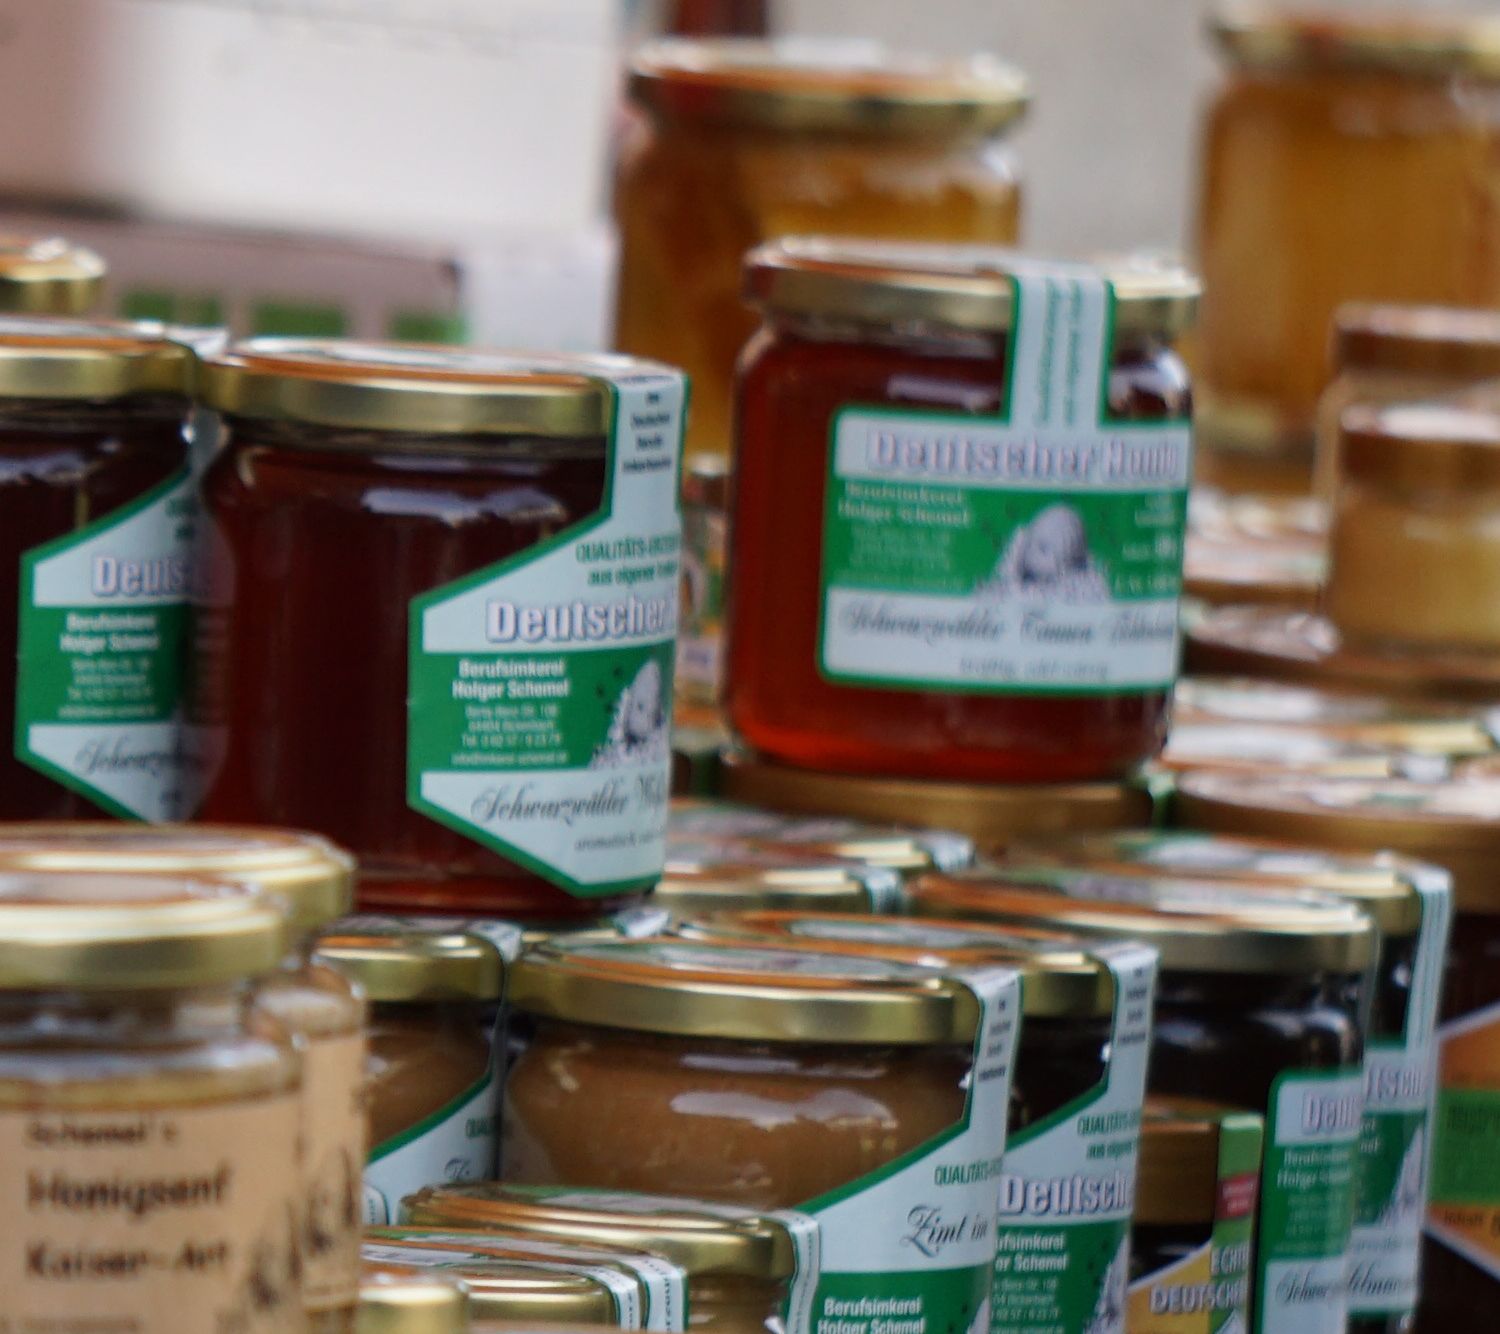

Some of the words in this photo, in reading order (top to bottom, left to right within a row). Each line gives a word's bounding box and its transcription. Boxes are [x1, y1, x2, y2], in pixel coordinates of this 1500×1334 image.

[868, 425, 1094, 479] Deutscher
[485, 596, 667, 643] Deutscher
[458, 659, 564, 678] Berufsimkerei
[452, 679, 505, 702] Holger
[507, 679, 570, 698] Schemel
[25, 1166, 230, 1216] Honigsenf
[999, 1173, 1133, 1217] Deutsche
[904, 1204, 966, 1259] Zimt
[996, 1233, 1065, 1252] ufsimkerei
[1014, 1252, 1070, 1272] Schemel
[823, 1296, 922, 1315] Berufsimkerei
[1151, 1280, 1247, 1314] DEUTSCHE
